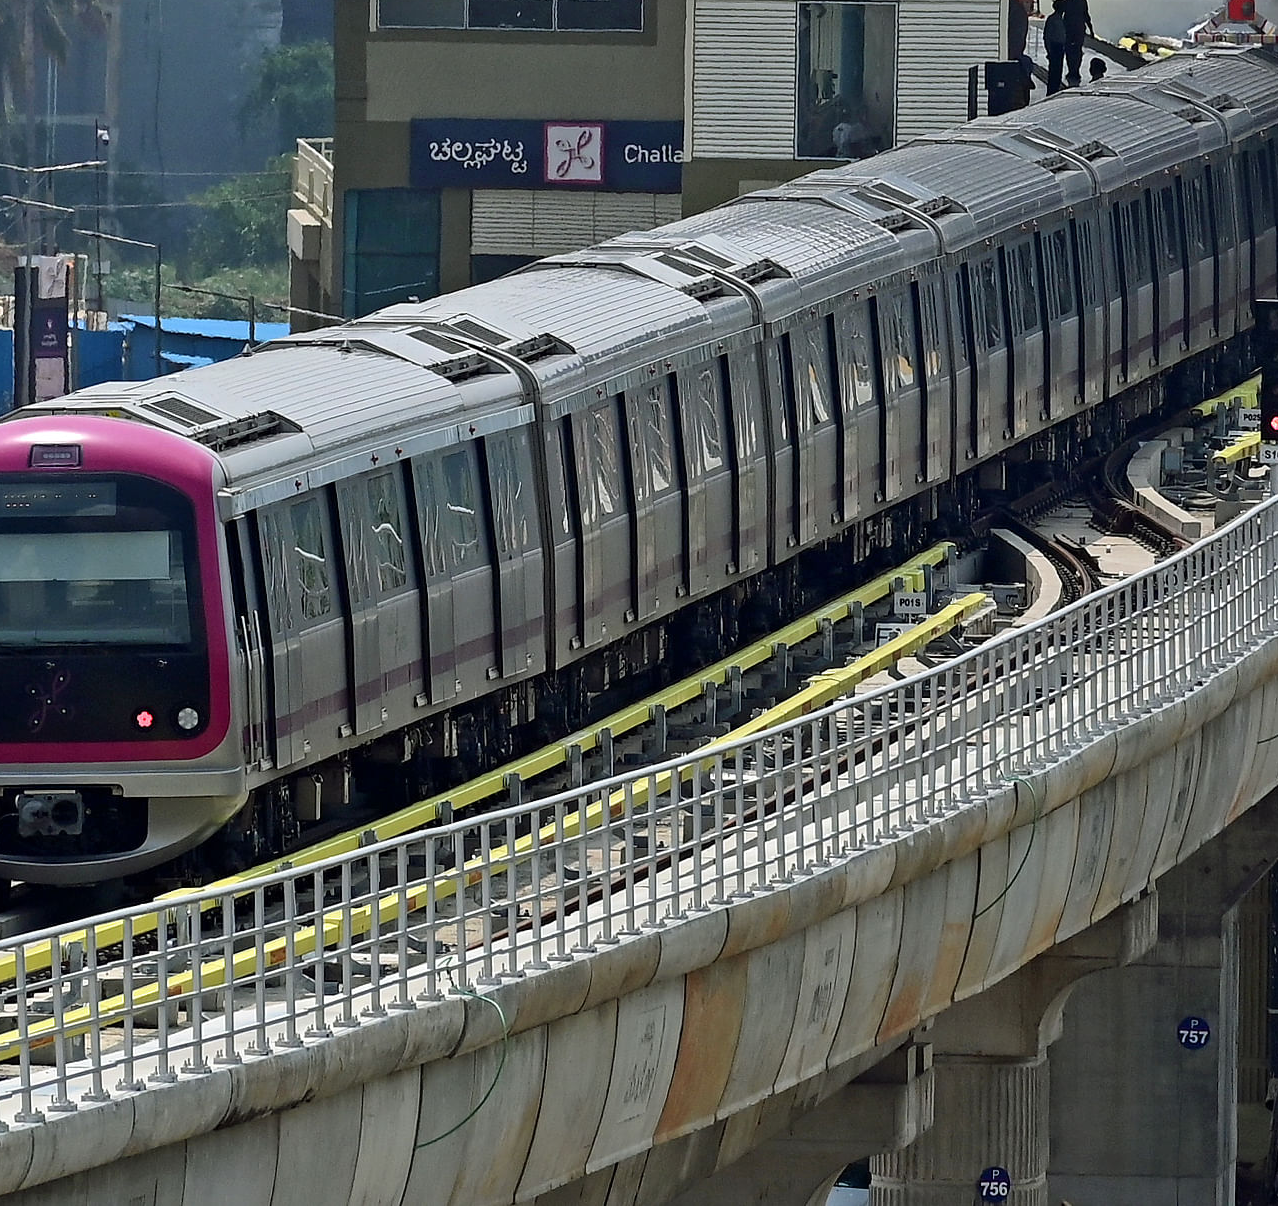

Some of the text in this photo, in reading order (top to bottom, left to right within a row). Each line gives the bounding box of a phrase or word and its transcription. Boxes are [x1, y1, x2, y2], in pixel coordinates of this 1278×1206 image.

[429, 137, 529, 174] ಚಲ್ಲಘಟ್ಟ
[899, 598, 921, 607] P01S
[1191, 1019, 1199, 1029] P
[1179, 1030, 1209, 1044] 757
[992, 1169, 1000, 1180] P
[980, 1181, 1008, 1197] 756
